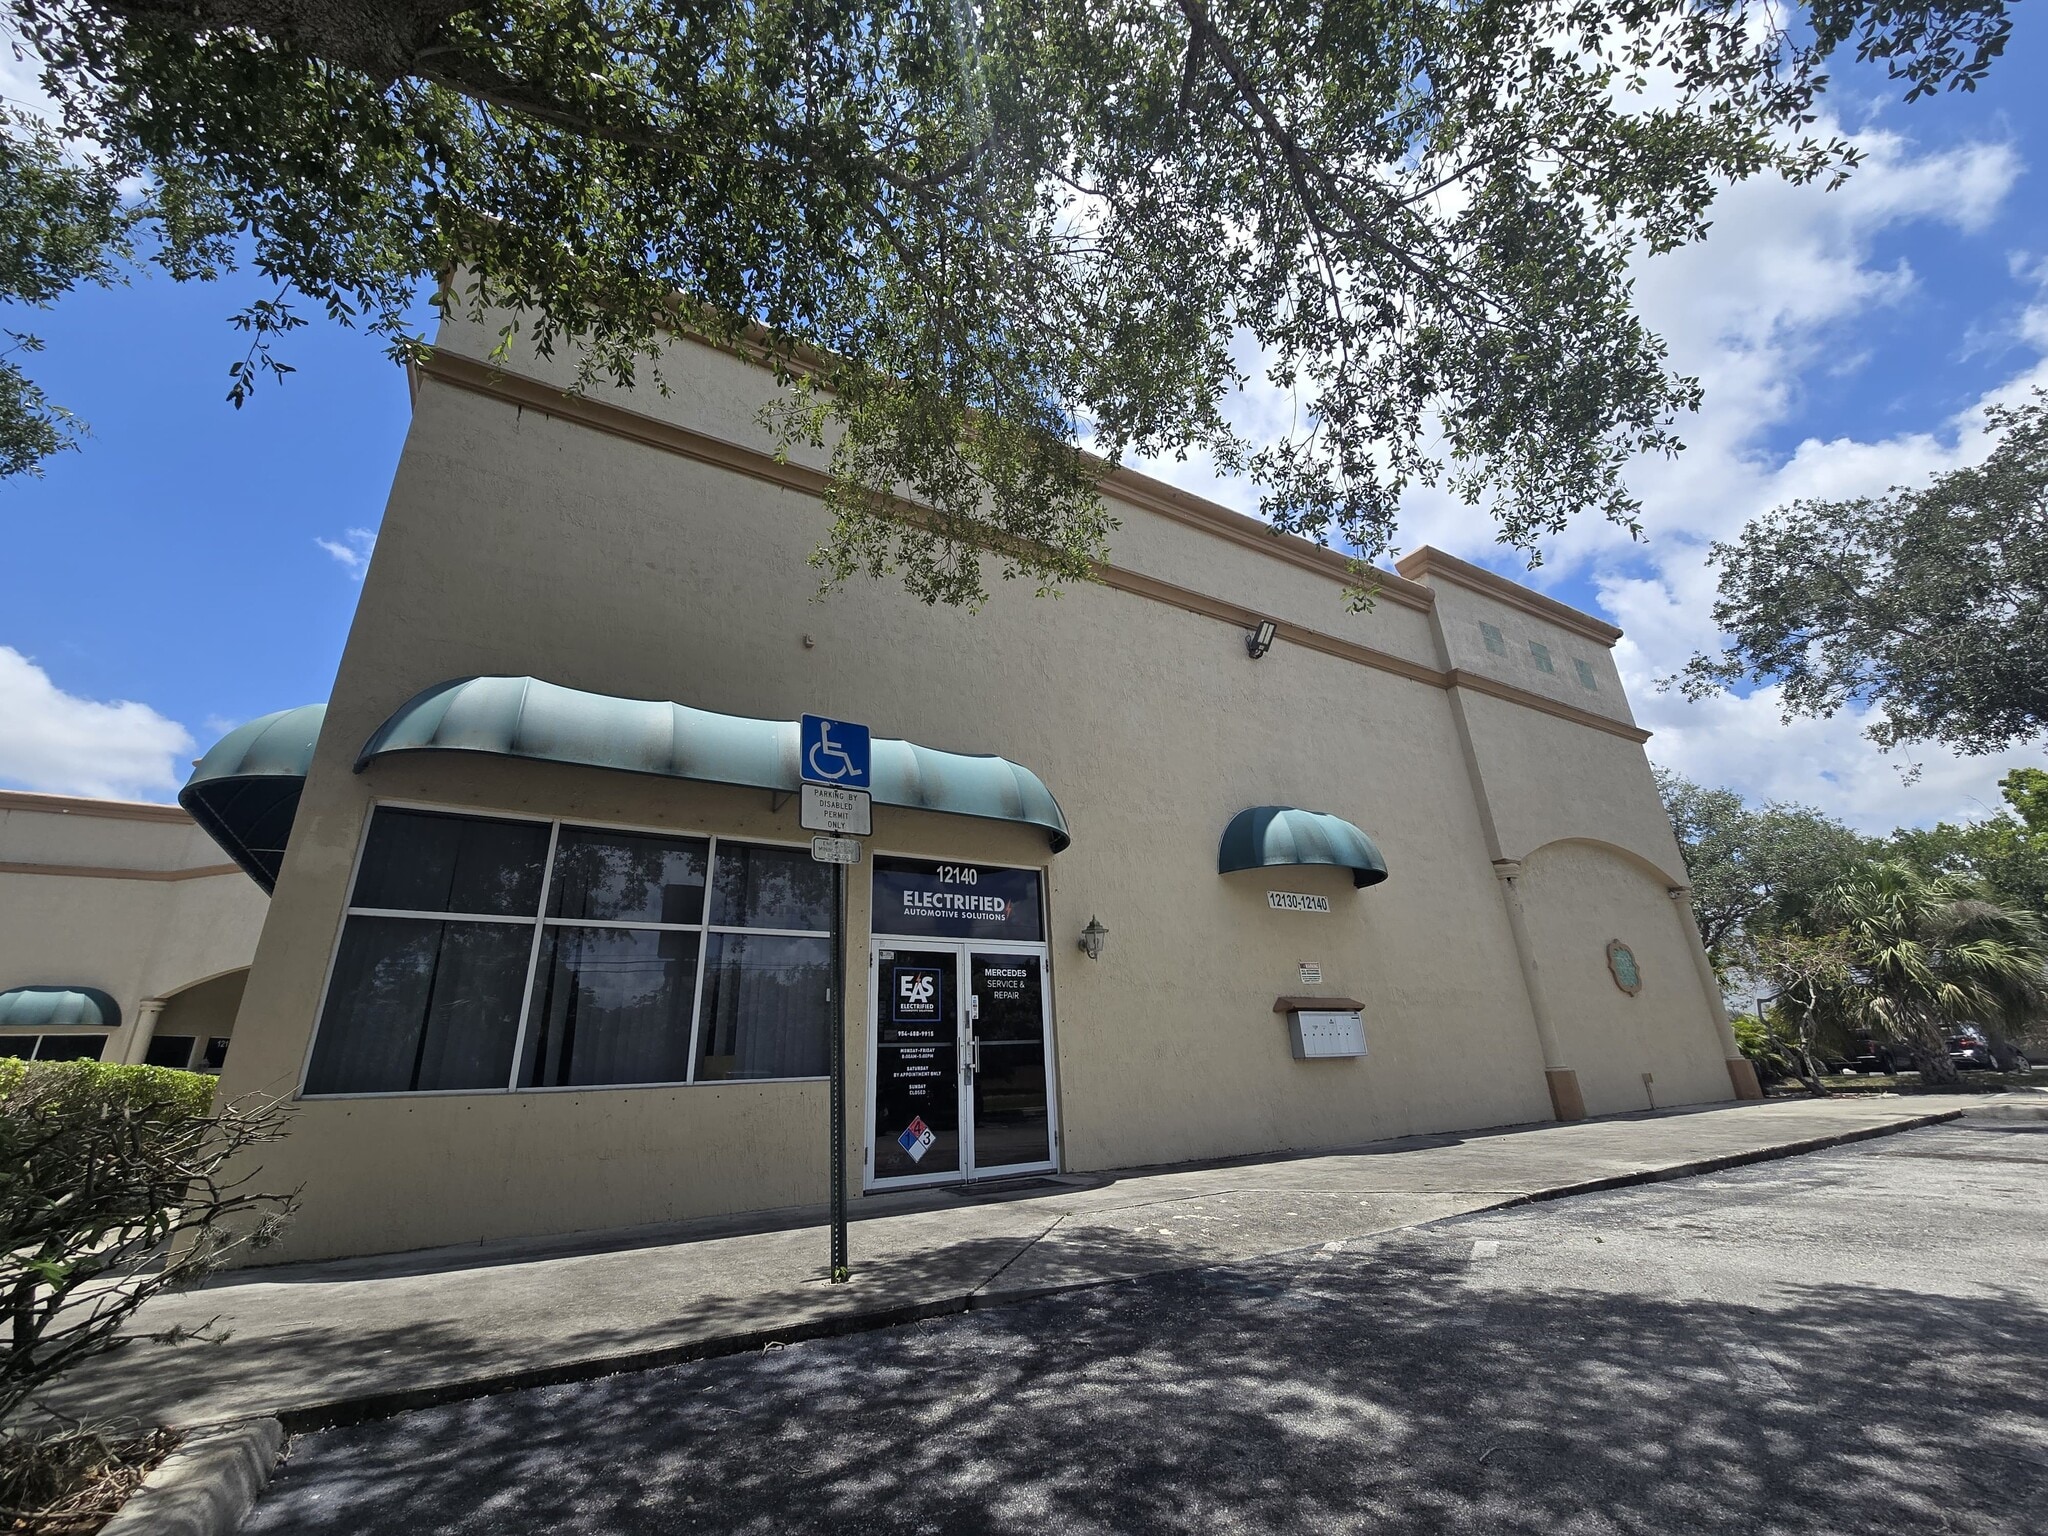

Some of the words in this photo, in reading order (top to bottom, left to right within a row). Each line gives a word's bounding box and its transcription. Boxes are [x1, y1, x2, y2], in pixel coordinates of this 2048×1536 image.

[814, 789, 844, 800] PARKING
[820, 800, 853, 811] DISABLED
[824, 810, 849, 820] PERMIT
[827, 821, 846, 829] ONLY
[936, 865, 978, 885] 12140
[903, 890, 1006, 912] ELECTRIFIED
[1269, 893, 1328, 911] 12130-12140
[903, 908, 959, 918] AUTOMOTIVE
[961, 911, 1006, 921] SOLUTIONS
[984, 968, 1027, 978] MERCEDES
[900, 975, 934, 1003] EAS
[987, 979, 1018, 989] SERVICE
[1019, 980, 1025, 989] &
[994, 990, 1020, 999] REPAIR
[913, 1120, 921, 1134] 4
[905, 1131, 910, 1147] 1
[922, 1130, 931, 1145] 3
